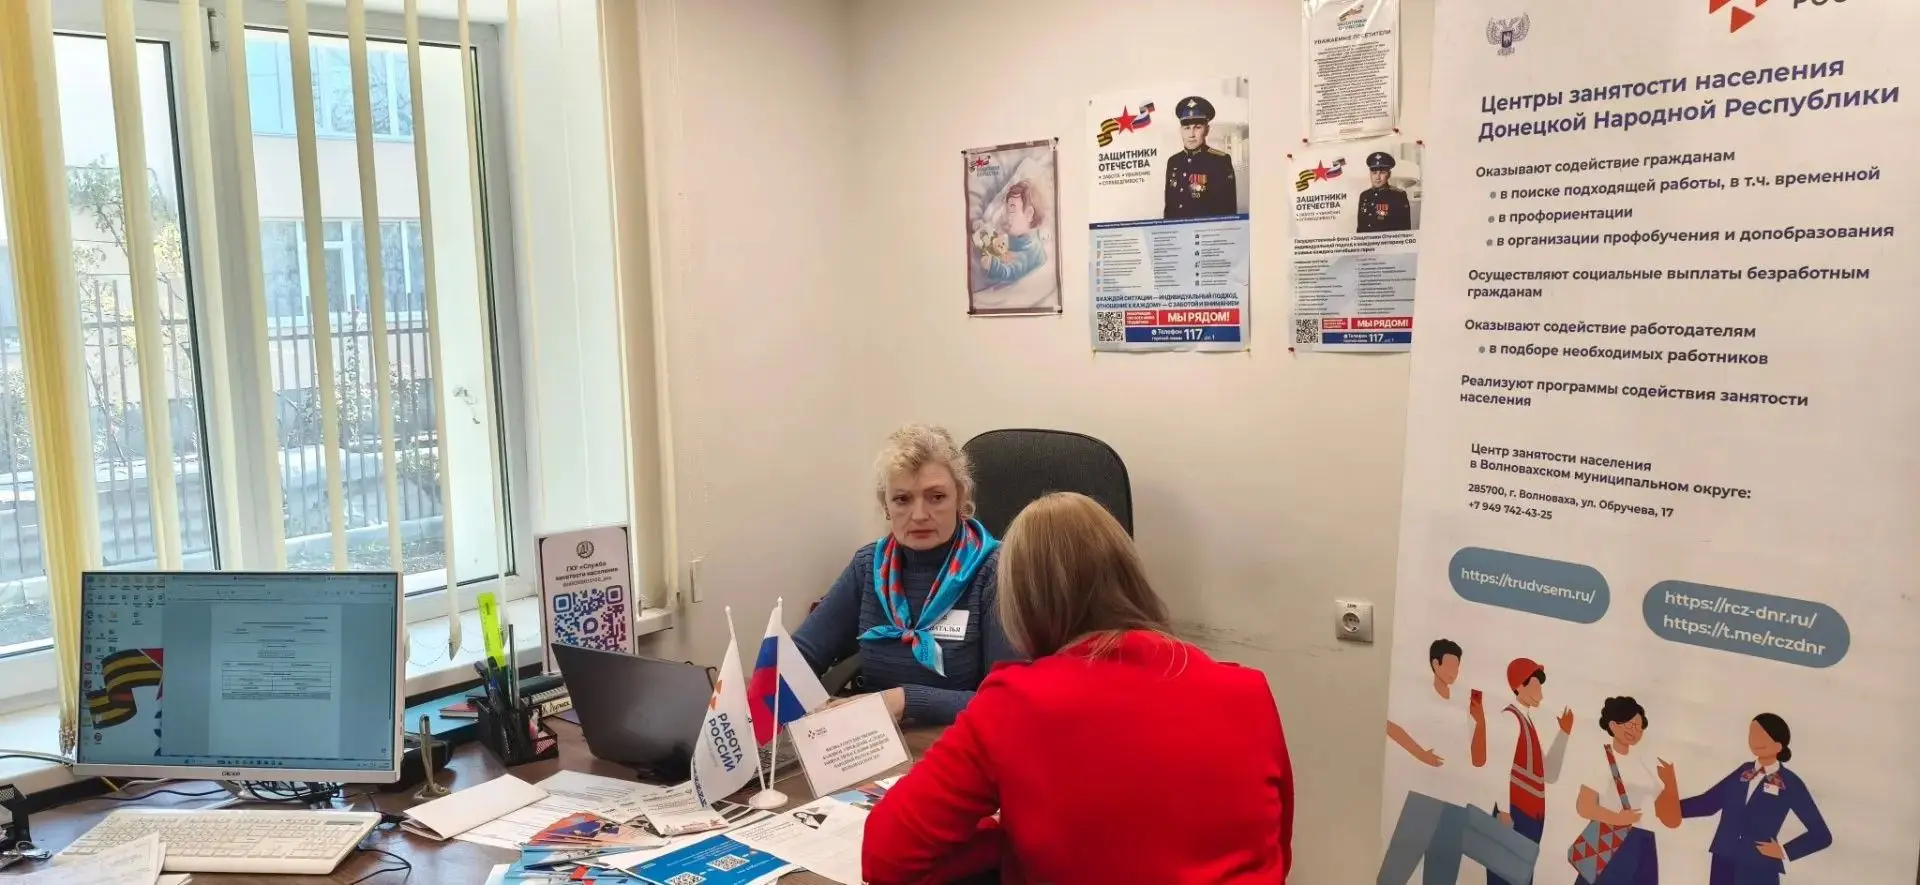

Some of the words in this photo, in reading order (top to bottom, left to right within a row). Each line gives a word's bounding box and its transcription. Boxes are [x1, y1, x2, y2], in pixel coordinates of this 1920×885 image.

[1482, 92, 1563, 115] Центры
[1568, 77, 1687, 103] занятости
[1696, 60, 1844, 90] населения
[1478, 112, 1586, 143] Донецкой
[1594, 104, 1716, 131] Народной
[1724, 87, 1899, 118] Республики
[1098, 148, 1157, 161] ЗАЩИТНИКИ
[1098, 158, 1150, 171] ОТЕЧЕСТВА
[1476, 164, 1552, 177] Оказывают
[1555, 157, 1640, 173] содействие
[1643, 152, 1735, 169] гражданам
[1501, 191, 1508, 199] в
[1511, 187, 1560, 199] поиске
[1564, 178, 1656, 197] подходящей
[1660, 176, 1725, 194] работы,
[1730, 178, 1739, 188] в
[1744, 176, 1770, 187] т.ч.
[1775, 166, 1880, 188] временной
[1296, 193, 1347, 203] ЗАЩИТНИКИ
[1296, 201, 1341, 210] ОТЕЧЕСТВА
[1499, 214, 1506, 223] в
[1509, 208, 1632, 224] профориентации
[1497, 237, 1504, 246] в
[1507, 234, 1599, 248] организации
[1604, 229, 1720, 246] профобучения
[1725, 231, 1735, 240] и
[1739, 226, 1894, 242] допобразования
[1469, 270, 1570, 283] Осуществляют
[1572, 270, 1663, 281] социальные
[1667, 270, 1742, 280] выплаты
[1747, 266, 1870, 282] безработным
[1468, 288, 1542, 299] гражданам
[1167, 312, 1187, 323] МЫ
[1188, 311, 1230, 323] РЯДОМ!
[1357, 319, 1372, 327] МЫ
[1373, 319, 1409, 328] РЯДОМ!
[1184, 328, 1203, 340] 117
[1369, 333, 1384, 342] 117
[1465, 319, 1541, 331] Оказывают
[1543, 320, 1627, 334] содействие
[1630, 322, 1756, 338] работодателям
[1489, 345, 1497, 353] в
[1501, 343, 1559, 358] подборе
[1563, 345, 1663, 360] необходимых
[1667, 349, 1768, 364] работников
[1460, 393, 1531, 406] населения
[1461, 375, 1534, 391] Реализуют
[1537, 381, 1619, 395] программы
[1622, 385, 1715, 400] содействия
[1720, 392, 1808, 406] занятости
[1472, 443, 1510, 459] Центр
[1512, 449, 1576, 464] занятости
[1580, 456, 1652, 471] населения
[1470, 460, 1477, 468] в
[1480, 457, 1571, 479] Волновахском
[1574, 471, 1689, 493] муниципальном
[1693, 484, 1751, 499] округе:
[1468, 484, 1507, 498] 285700,
[1510, 489, 1516, 500] г.
[1519, 489, 1579, 507] Волноваха,
[1581, 498, 1596, 508] ул.
[1599, 500, 1658, 518] Обручева,
[1661, 507, 1674, 517] 17
[1469, 500, 1480, 509] +7
[1482, 502, 1501, 512] 949
[1503, 504, 1552, 520] 742-43-25
[1462, 568, 1595, 603] https://trudvsem.ru/
[1665, 590, 1817, 629] https://rcz-dnr.ru/
[1664, 612, 1825, 655] https://t.me/rczdnr
[708, 718, 735, 772] РОССИИ
[718, 713, 743, 764] РАБОТА
